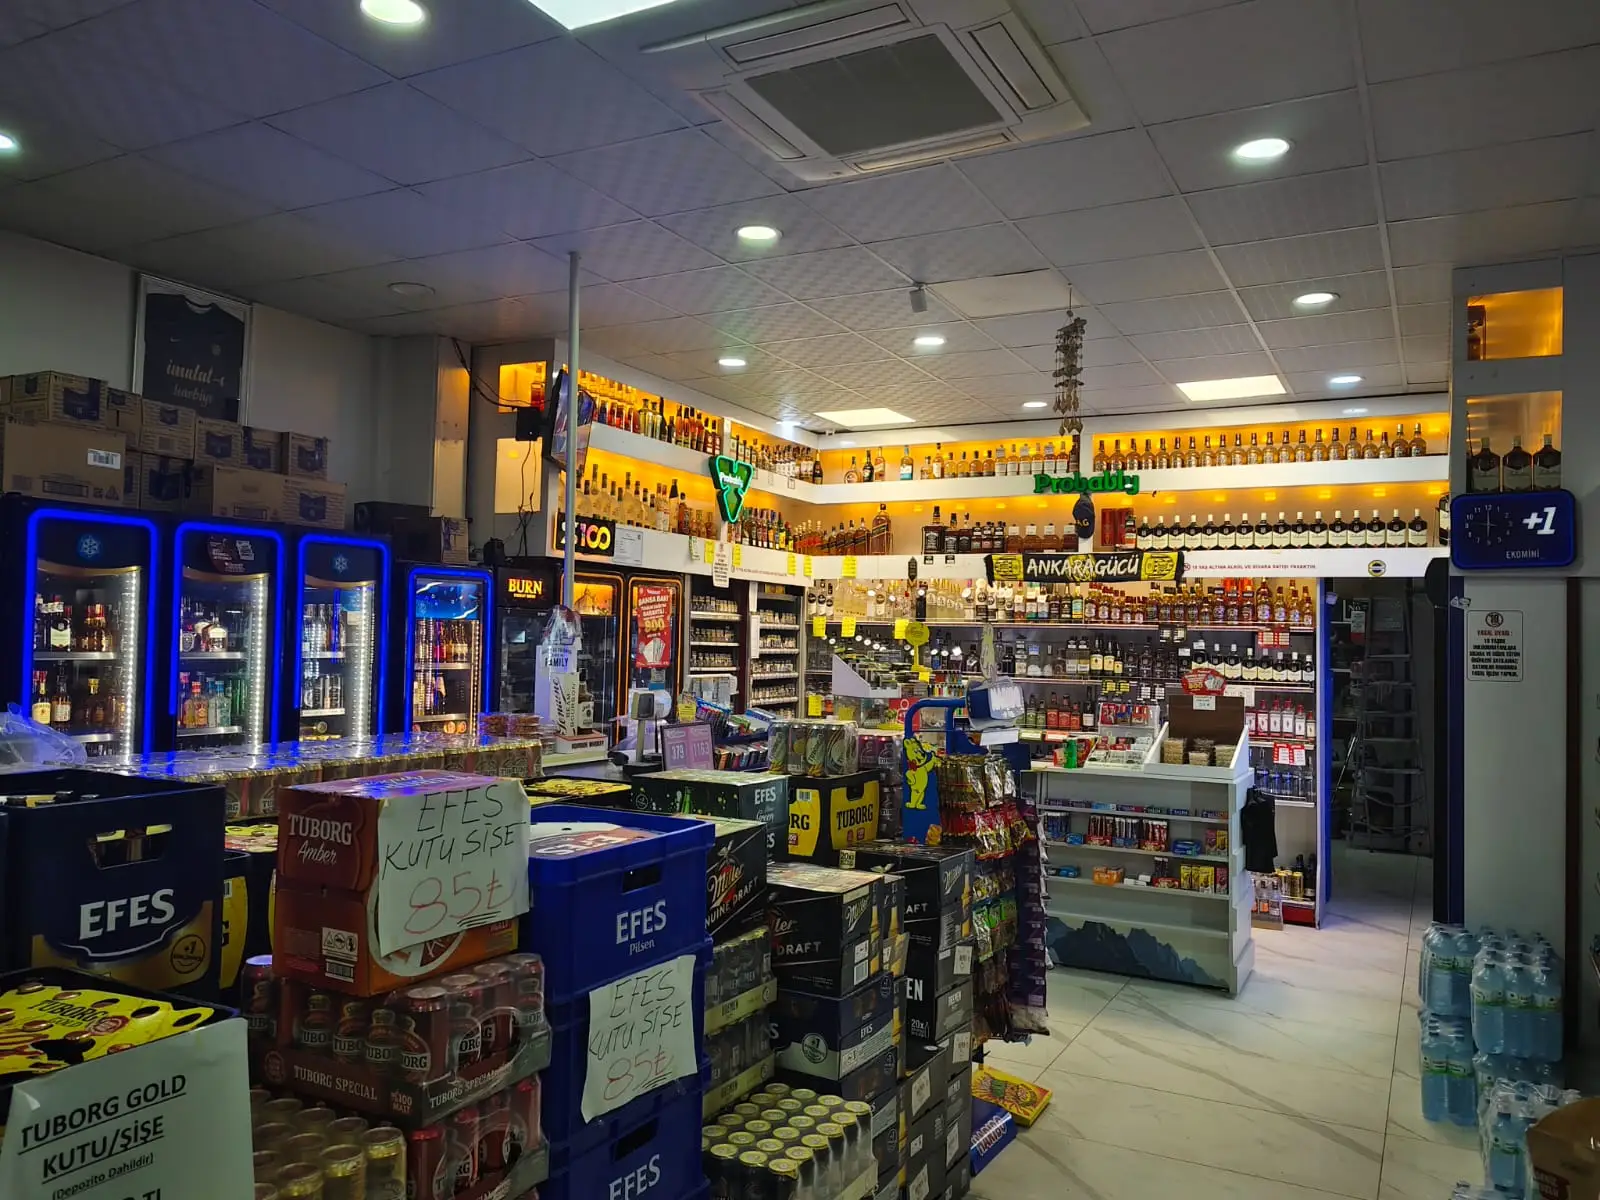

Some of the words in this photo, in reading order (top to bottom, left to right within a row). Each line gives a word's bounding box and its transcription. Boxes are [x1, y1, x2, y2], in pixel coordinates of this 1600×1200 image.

[1033, 469, 1139, 496] Probably
[1522, 506, 1557, 535] +1
[1026, 554, 1139, 577] ANKARAGÜCÜ
[508, 578, 543, 595] BURN
[545, 658, 568, 667] FAMILY
[417, 784, 503, 832] EFES
[754, 786, 776, 805] EFES
[288, 813, 352, 845] TUBORG
[836, 804, 873, 831] TUBORG
[298, 840, 337, 865] Amber
[382, 834, 455, 880] KUTU
[79, 888, 175, 941] EFES
[704, 902, 731, 929] NUINE
[733, 876, 758, 906] DRAFT
[905, 902, 928, 914] AFT
[616, 900, 667, 945] EFES
[629, 938, 655, 956] Pilsen
[776, 941, 822, 956] DRAFT
[610, 970, 675, 1018] EFES
[294, 1065, 333, 1088] TUBORG
[335, 1077, 378, 1100] SPECIAL
[430, 1084, 463, 1109] TUBORG
[21, 1096, 119, 1148] TUBORG
[127, 1074, 187, 1108] GOLD
[43, 1115, 164, 1178] KUTU/ŞİŞE
[52, 1173, 106, 1200] (Depozito
[109, 1152, 154, 1178] Dahildir)
[609, 1154, 661, 1200] EFES
